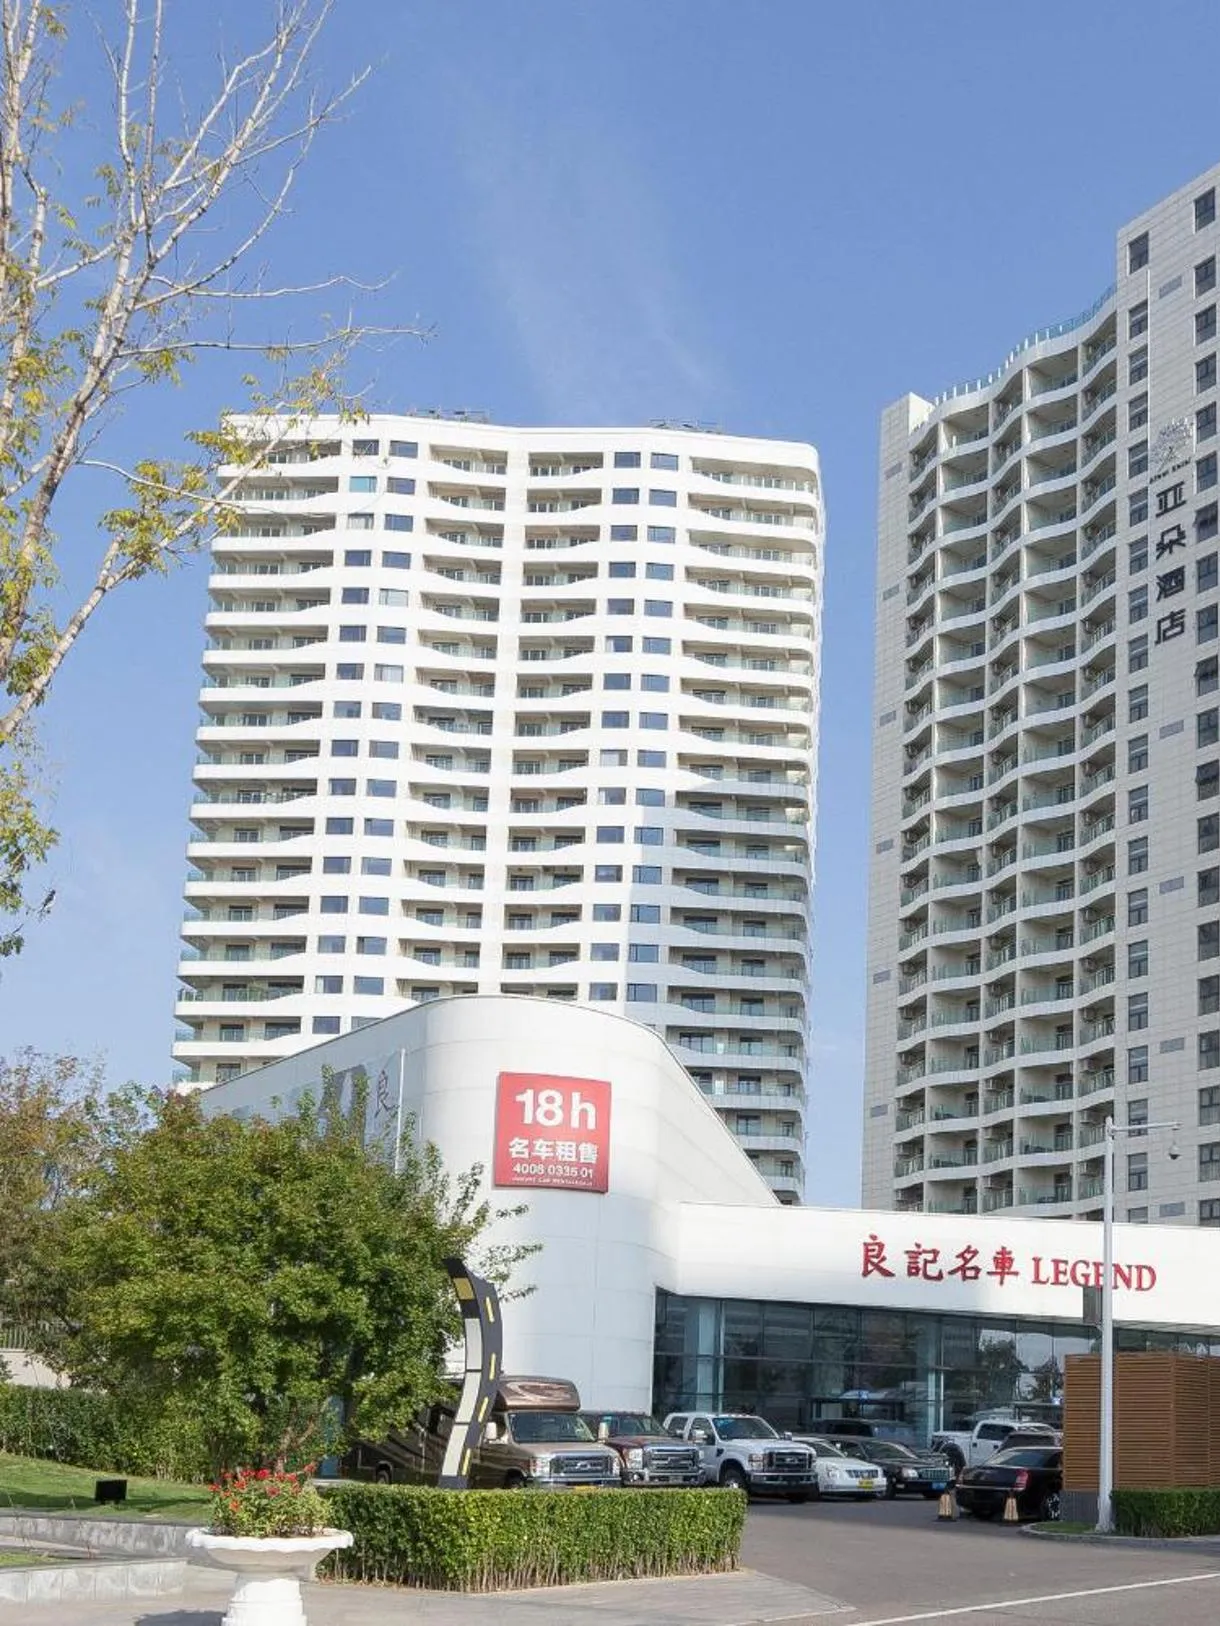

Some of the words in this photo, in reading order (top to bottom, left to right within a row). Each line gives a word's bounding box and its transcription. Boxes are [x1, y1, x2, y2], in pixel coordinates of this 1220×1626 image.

[1154, 481, 1186, 646] 亚朵酒店
[508, 1137, 599, 1165] 名车租售
[861, 1234, 1019, 1285] 良記名車
[1031, 1256, 1157, 1291] LEGEND
